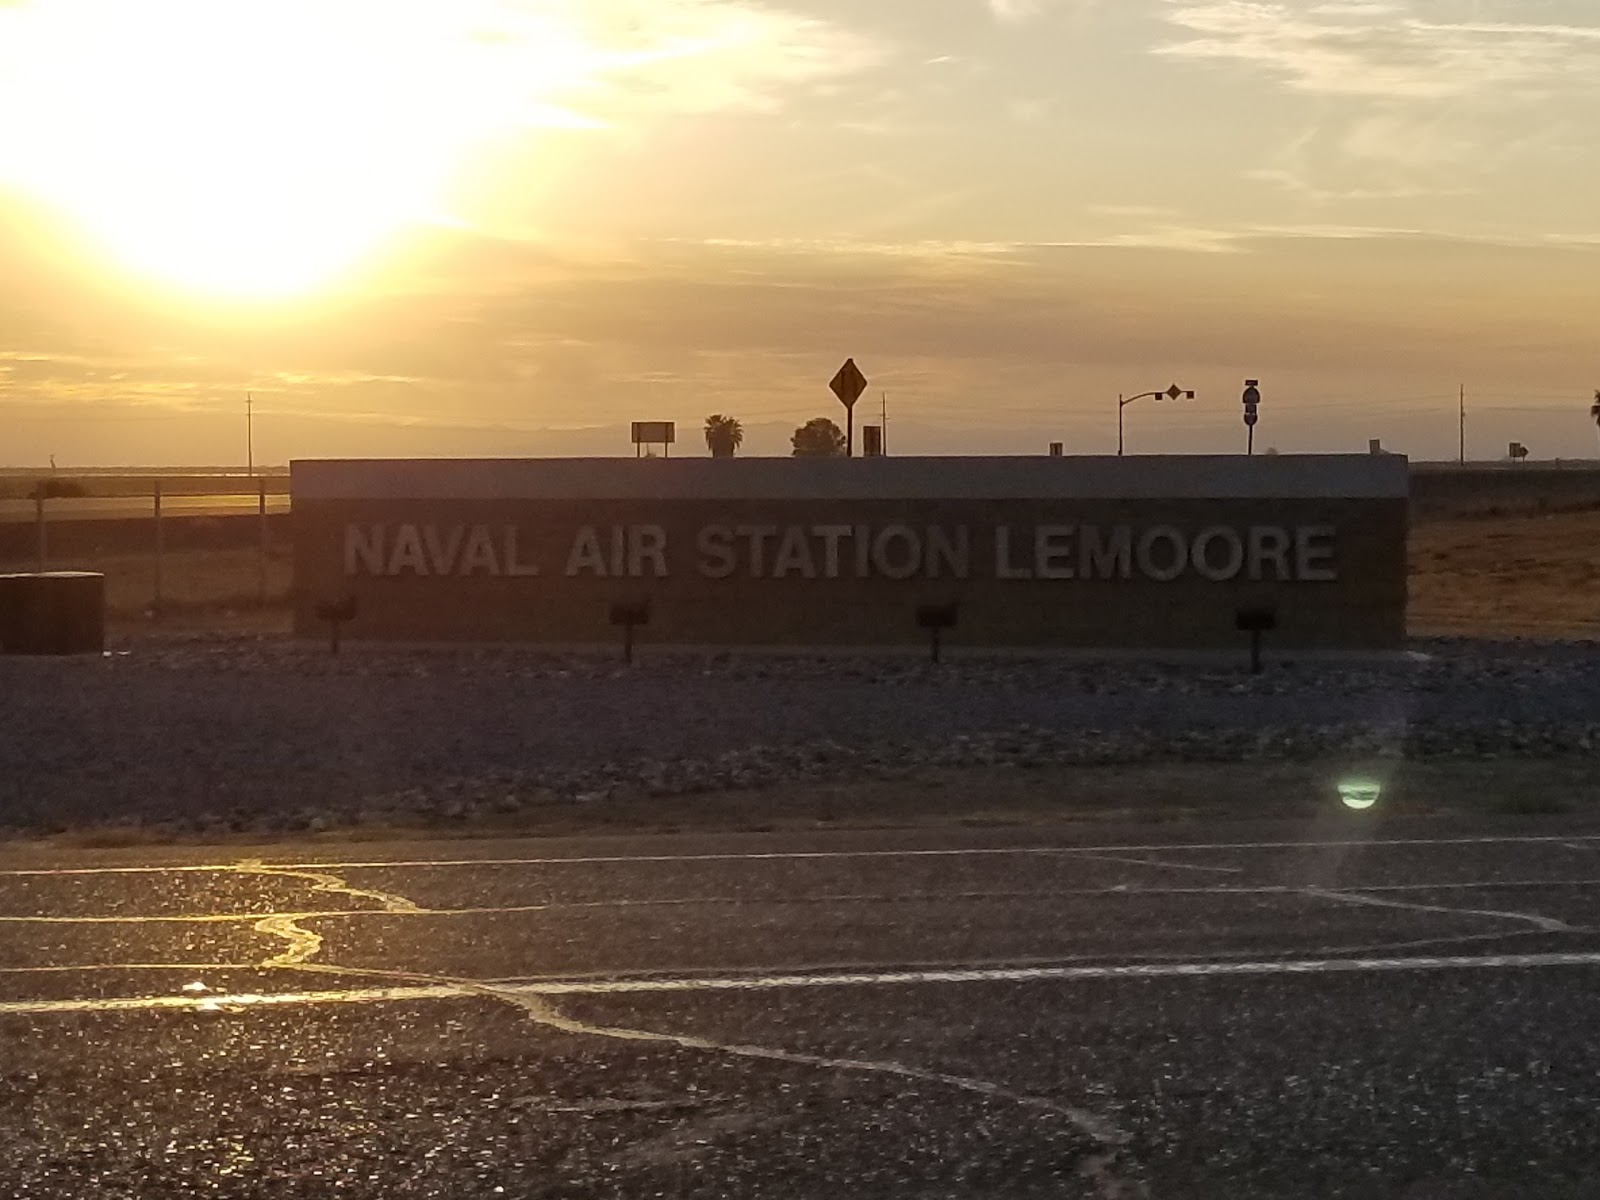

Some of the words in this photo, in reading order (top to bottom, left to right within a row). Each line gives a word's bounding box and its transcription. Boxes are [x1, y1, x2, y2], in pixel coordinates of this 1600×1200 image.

[343, 523, 538, 577] NAVAL
[565, 523, 669, 578] AIR
[696, 524, 968, 579] STATION
[995, 524, 1337, 582] LEMOORE
